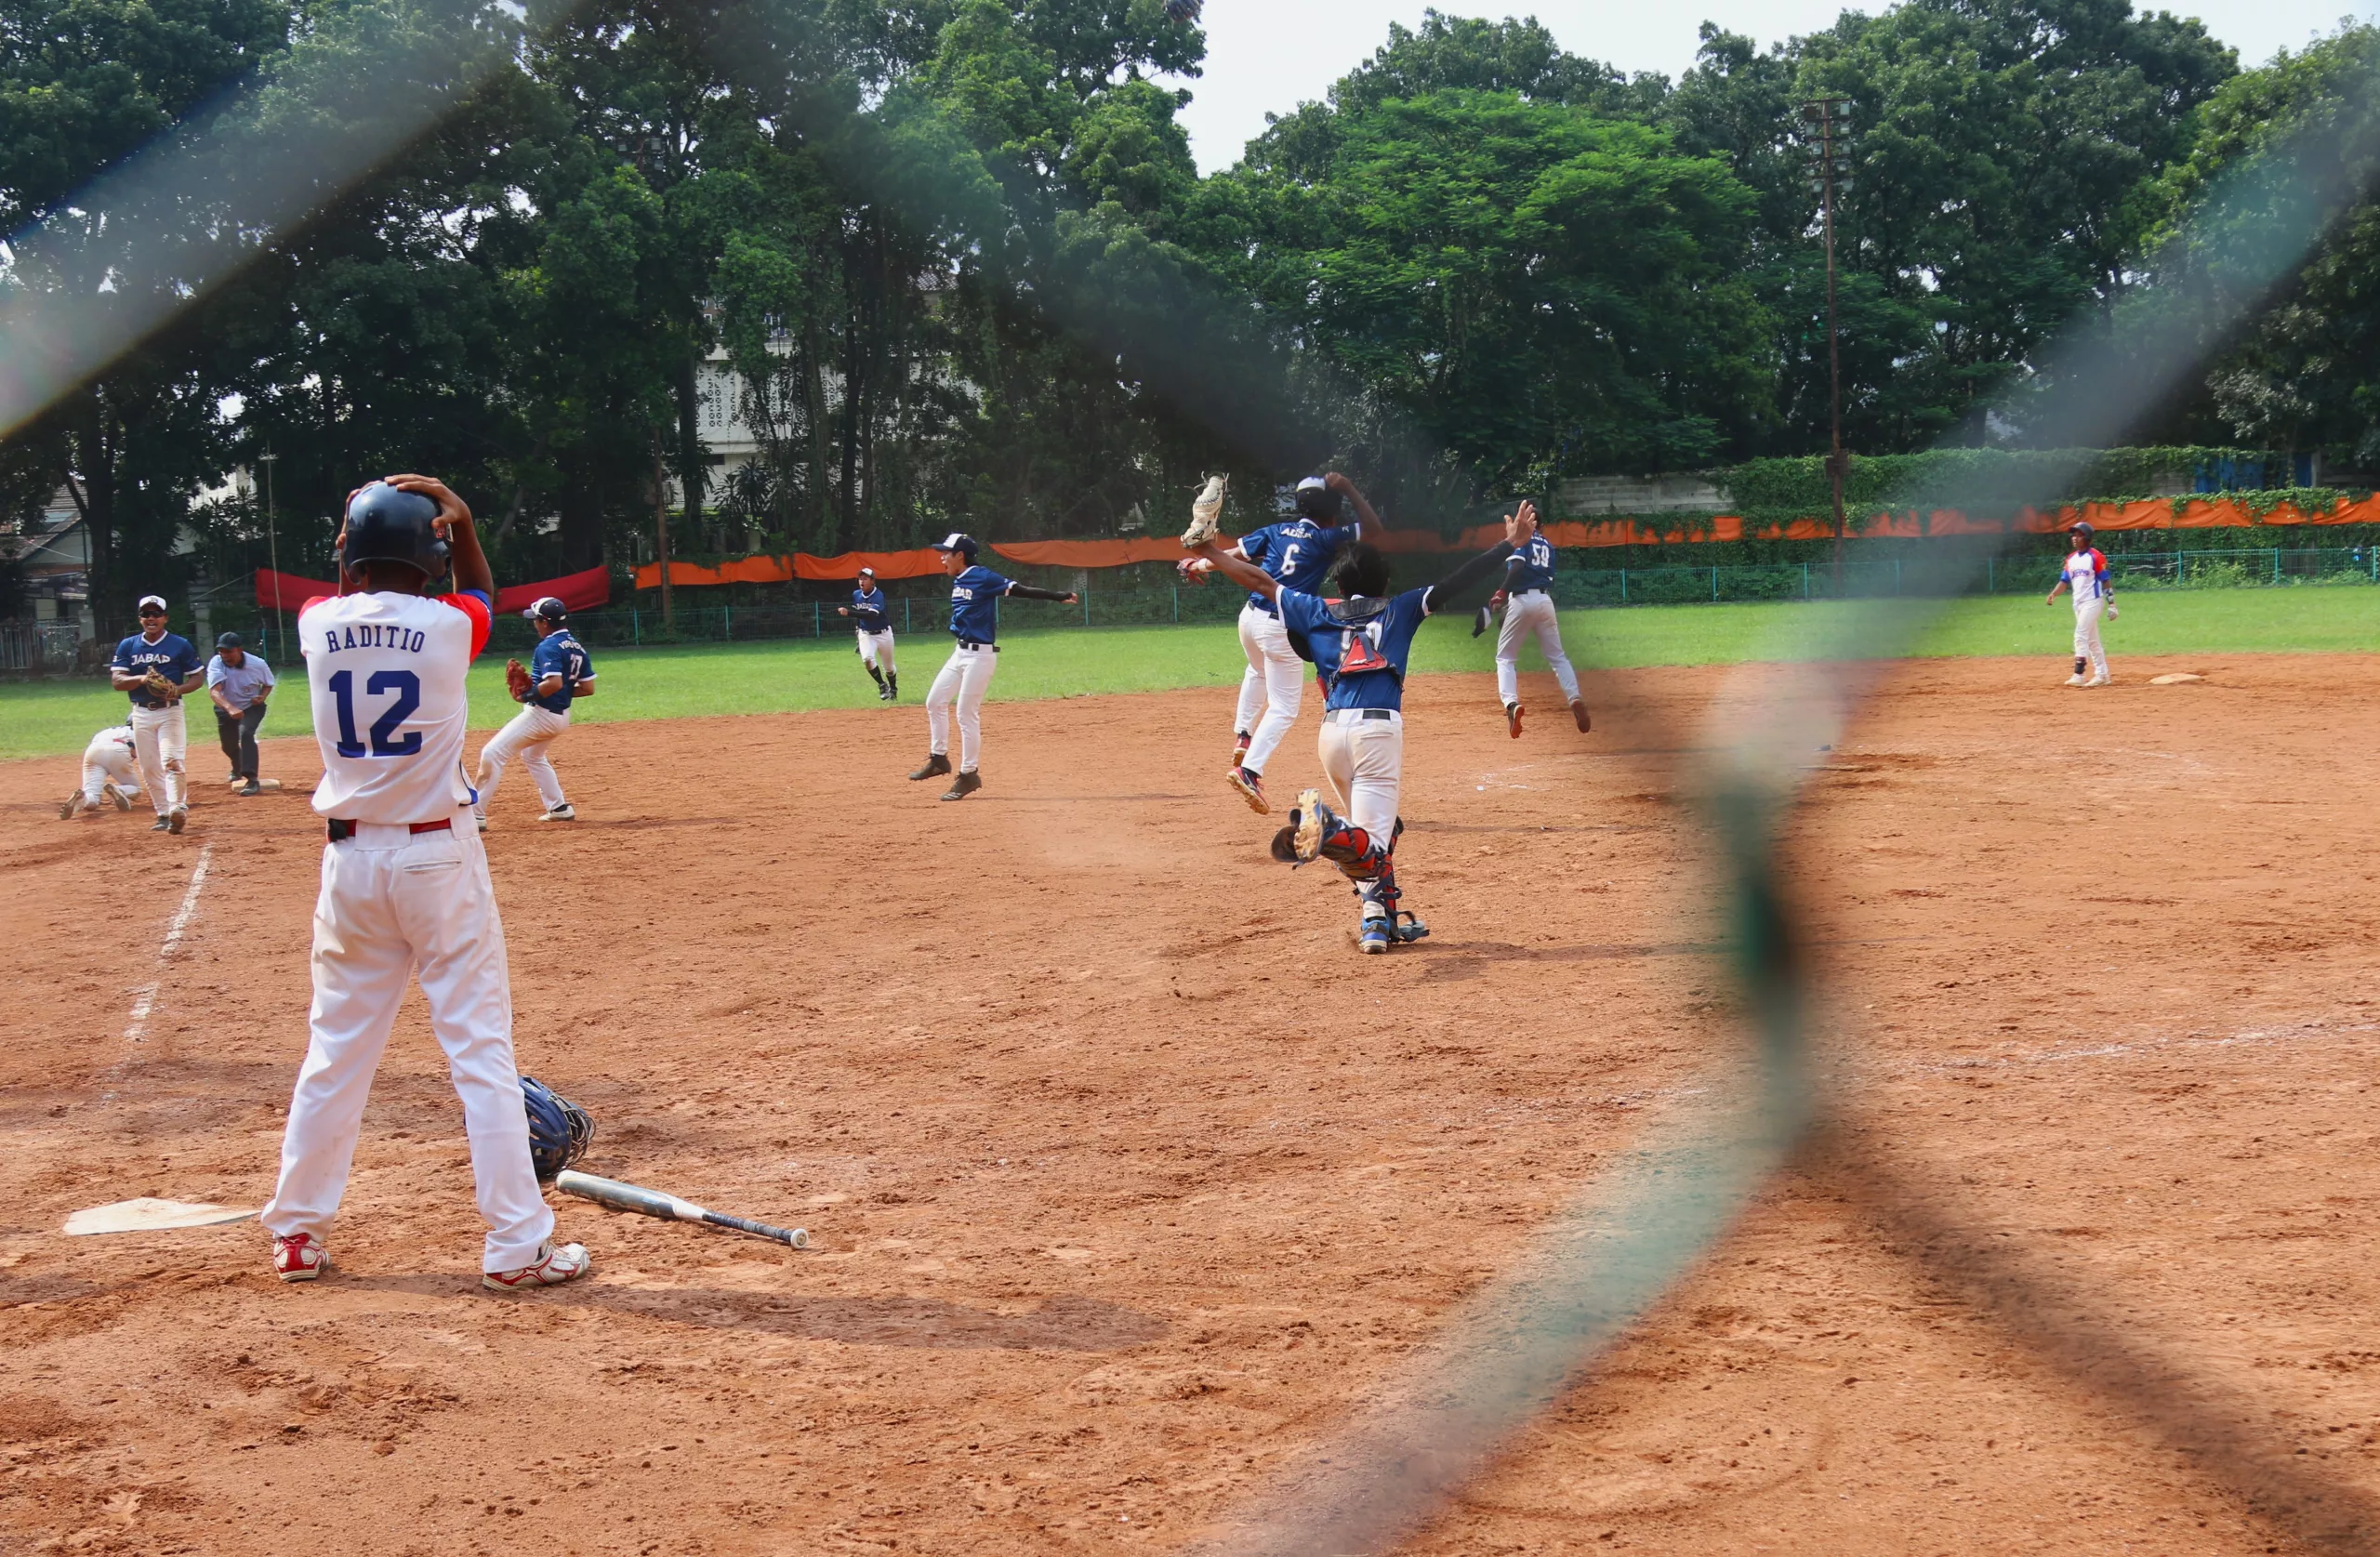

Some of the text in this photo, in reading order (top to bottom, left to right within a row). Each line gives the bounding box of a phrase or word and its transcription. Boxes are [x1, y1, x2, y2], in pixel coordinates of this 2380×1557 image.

[1281, 544, 1300, 575] 6
[1531, 543, 1550, 568] 59
[325, 625, 426, 653] RADITIO
[328, 669, 423, 759] 12
